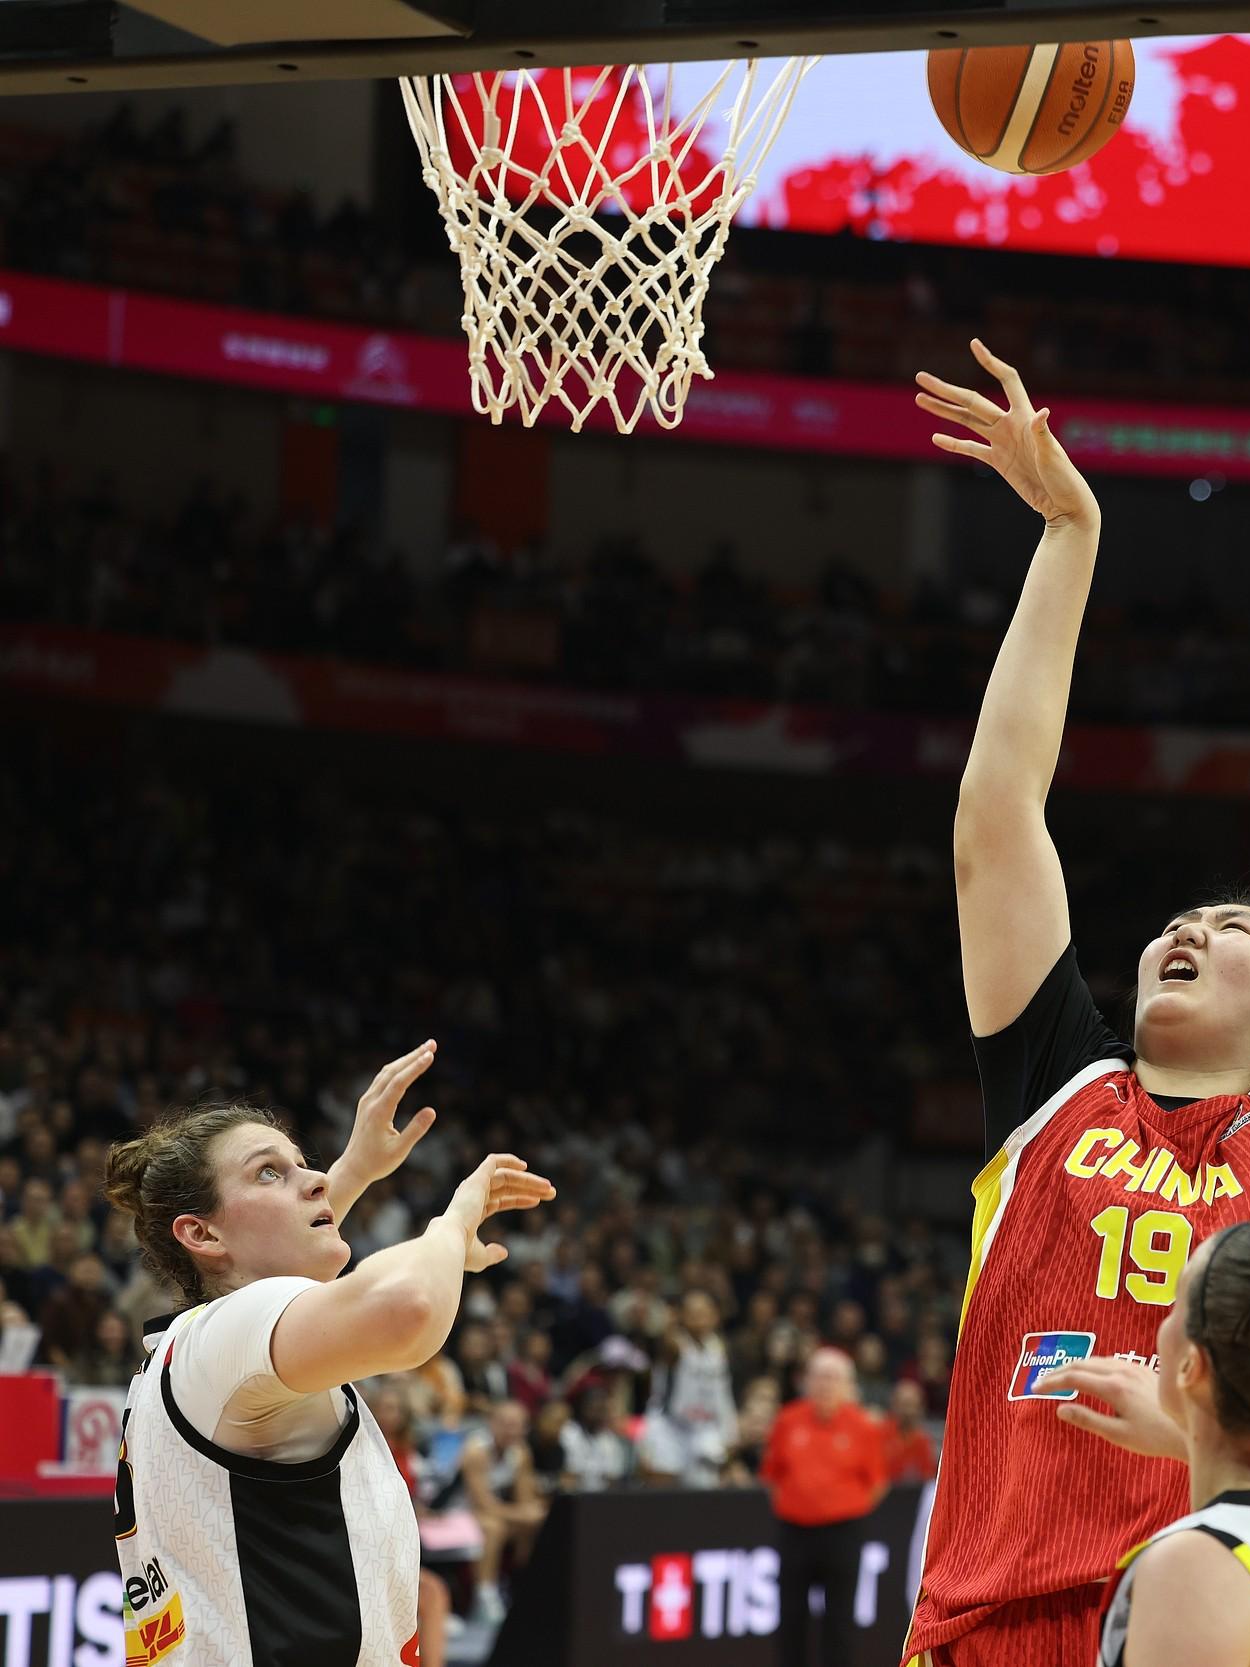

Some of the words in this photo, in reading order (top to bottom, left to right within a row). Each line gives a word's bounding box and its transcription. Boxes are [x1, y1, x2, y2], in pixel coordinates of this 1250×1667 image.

[1057, 45, 1099, 136] molten
[1107, 80, 1130, 125] FIBA
[1063, 1127, 1244, 1207] CHINA
[1090, 1205, 1194, 1307] 19
[0, 1570, 124, 1667] TIS
